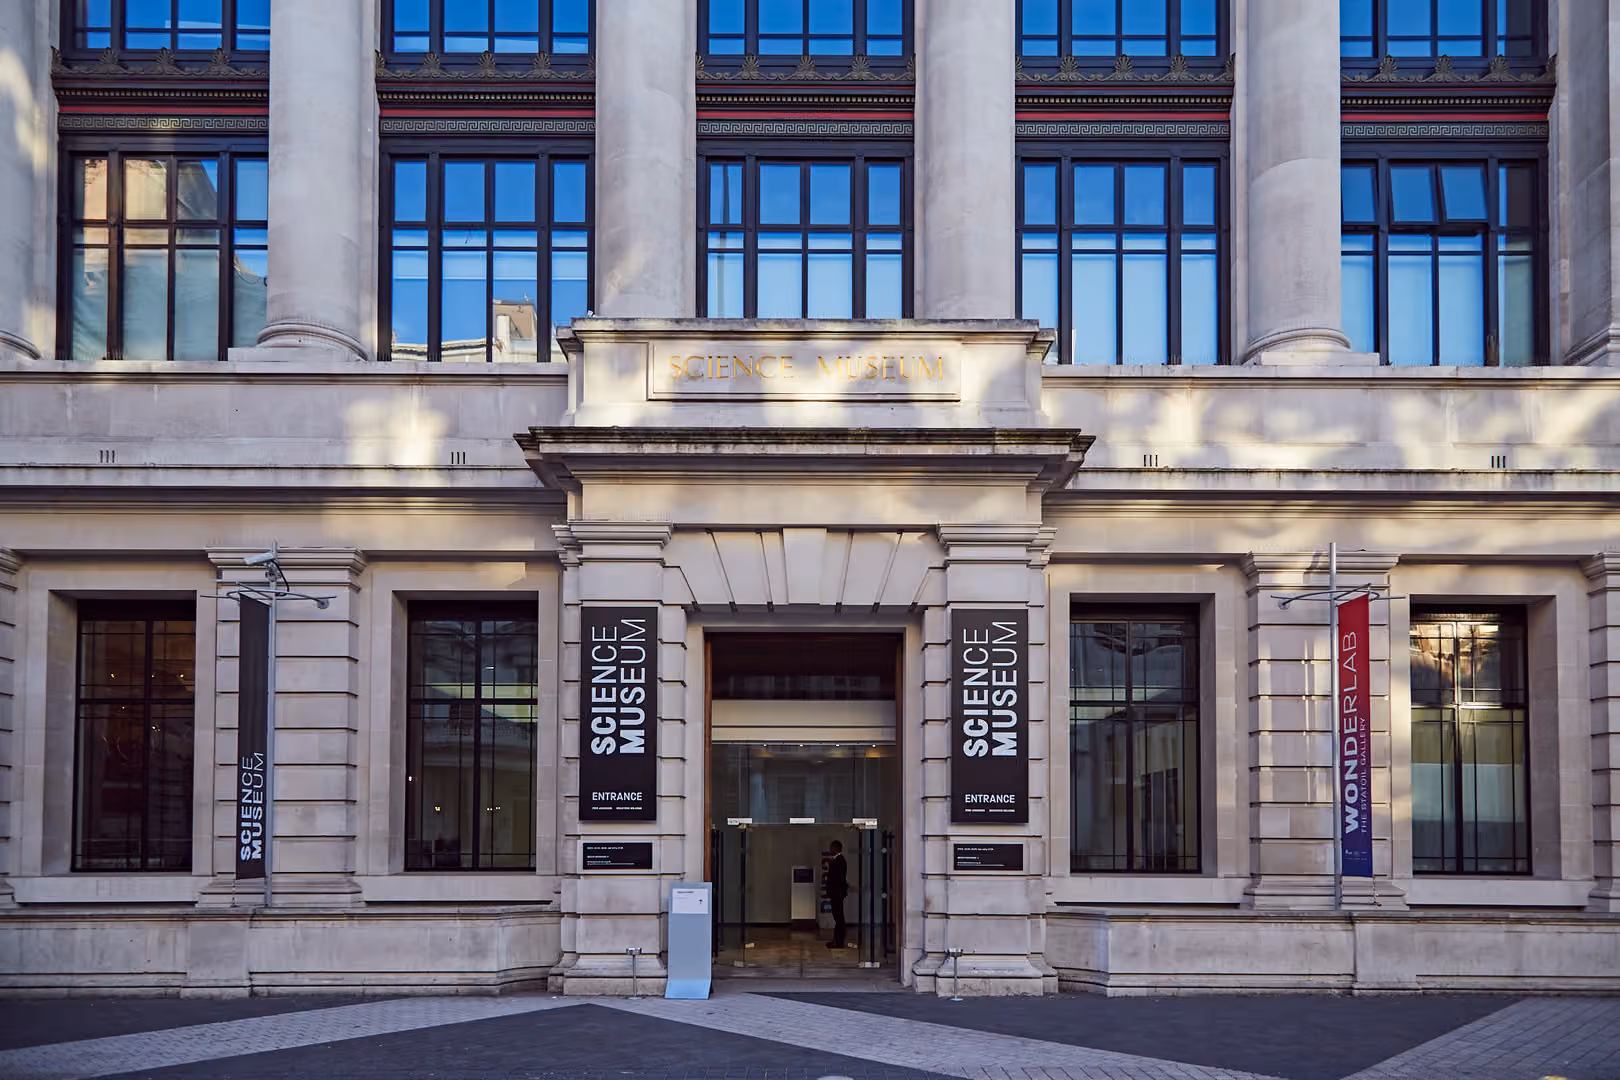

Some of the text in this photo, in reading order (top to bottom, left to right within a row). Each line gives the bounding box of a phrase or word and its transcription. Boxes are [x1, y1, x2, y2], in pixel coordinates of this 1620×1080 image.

[668, 355, 944, 380] SCIENCE MUSEUM
[591, 626, 617, 755] SCIENCE
[619, 619, 646, 754] MUSEUM
[963, 628, 989, 758] SCIENCE
[992, 621, 1018, 757] MUSEUM
[1343, 631, 1359, 834] WONDERLAB
[240, 756, 253, 861] SCIENCE
[251, 752, 264, 860] MUSEUM
[592, 791, 643, 801] ENTRANCE
[965, 794, 1016, 804] ENTRANCE
